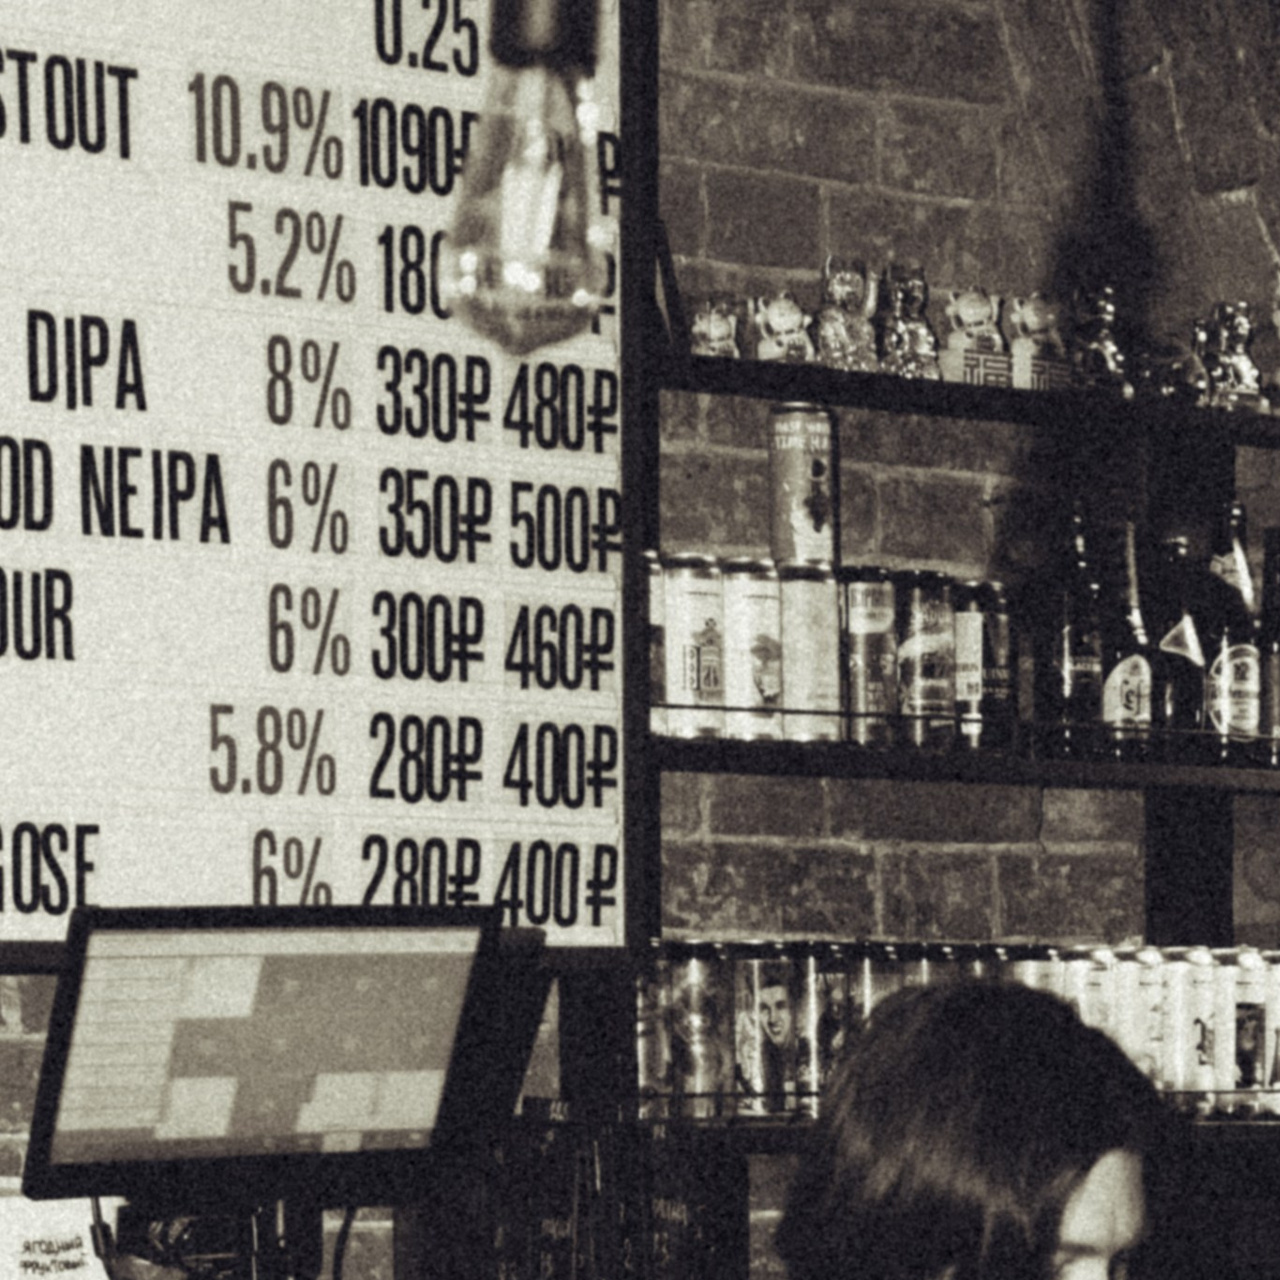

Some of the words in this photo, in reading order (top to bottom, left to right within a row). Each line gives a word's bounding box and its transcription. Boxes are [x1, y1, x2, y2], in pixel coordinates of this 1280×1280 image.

[373, 0, 480, 77] 0.25
[0, 48, 138, 160] TOUT
[188, 72, 344, 181] 10.9%
[227, 201, 356, 303] 5.2%
[26, 309, 147, 412] DIPA
[266, 334, 352, 430] 8%
[376, 345, 491, 443] 330₽
[502, 362, 619, 454] 480₽
[80, 444, 231, 544] NEIPA
[266, 458, 349, 554] 6%
[378, 467, 493, 563] 350₽
[510, 481, 622, 573] 500₽
[268, 583, 351, 677] 6%
[371, 590, 485, 682] 300₽
[503, 604, 616, 691] 460₽
[209, 703, 337, 797] 5.8%
[368, 712, 484, 801] 280₽
[502, 722, 619, 808] 400₽
[0, 821, 99, 915] OSE
[252, 828, 333, 905] 6%
[361, 834, 482, 905] 280₽
[494, 839, 618, 927] 400₽
